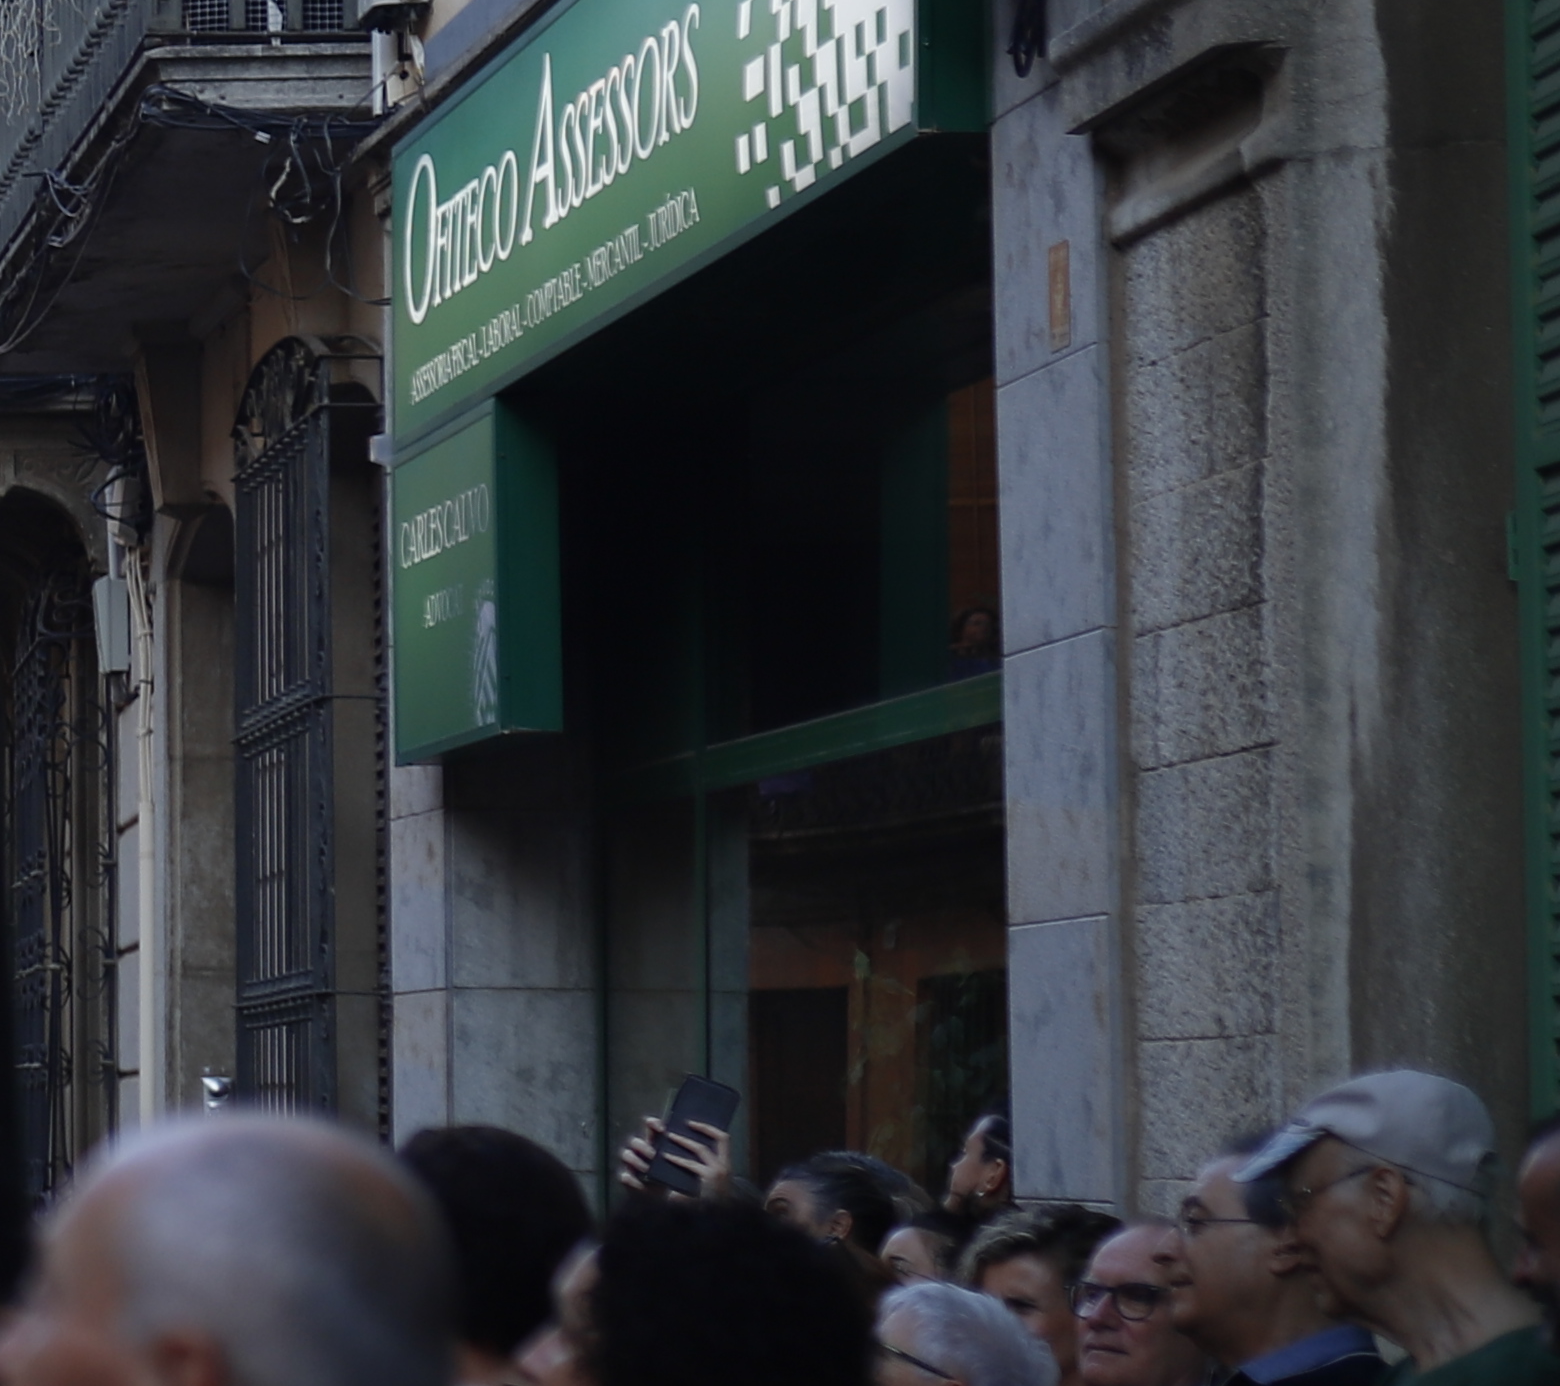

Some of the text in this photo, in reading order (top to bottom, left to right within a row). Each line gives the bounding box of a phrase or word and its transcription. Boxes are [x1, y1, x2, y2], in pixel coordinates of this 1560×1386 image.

[481, 303, 524, 359] LABORAL
[527, 262, 584, 329] COMPTABLE
[587, 223, 644, 291] MERCANTIL
[646, 186, 700, 252] JURÍDICA
[401, 483, 489, 570] CARLES CALVO
